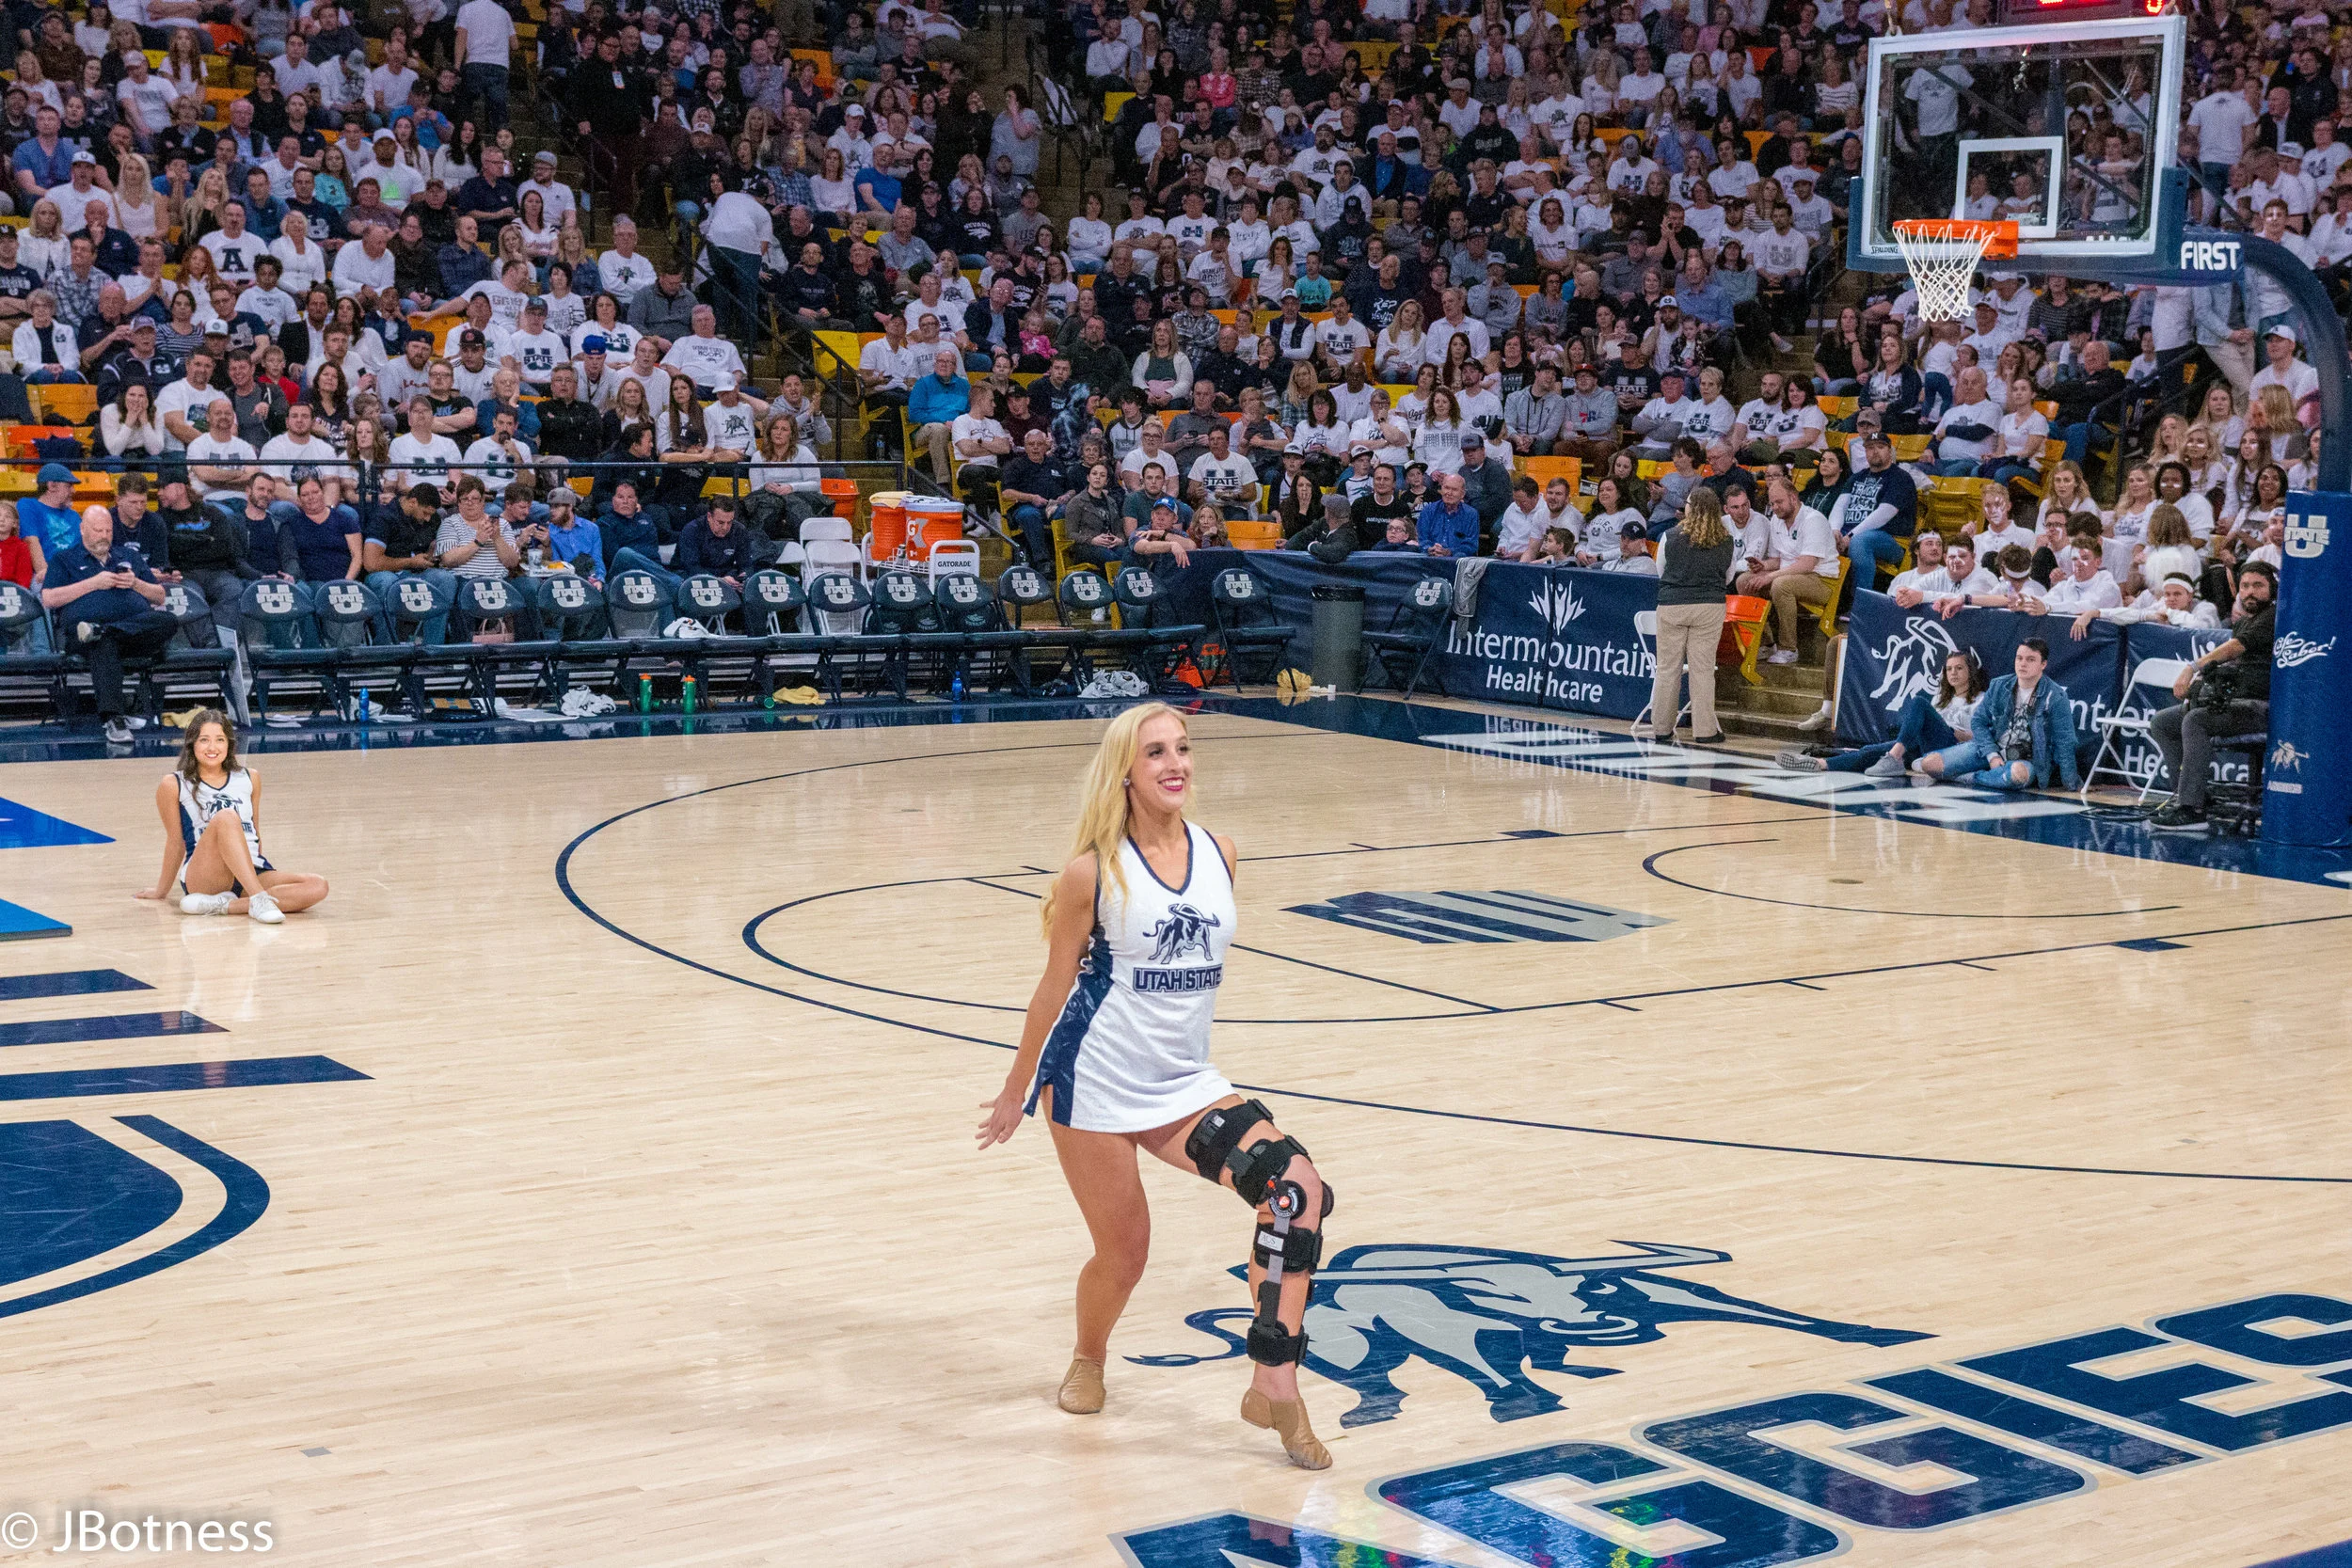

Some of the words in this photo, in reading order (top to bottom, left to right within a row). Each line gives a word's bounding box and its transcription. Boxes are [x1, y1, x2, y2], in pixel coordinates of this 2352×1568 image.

[222, 247, 248, 273] A
[1870, 245, 1899, 255] SPALDING
[2181, 241, 2242, 270] FIRST
[1203, 476, 1239, 486] STATE
[908, 520, 916, 536] G
[2284, 527, 2330, 545] STATE
[1446, 621, 1657, 678] Intermountain
[2277, 636, 2337, 669] Sabor!
[1486, 664, 1603, 703] Healthcare
[1133, 967, 1184, 993] UTAH
[1184, 964, 1223, 992] STATE
